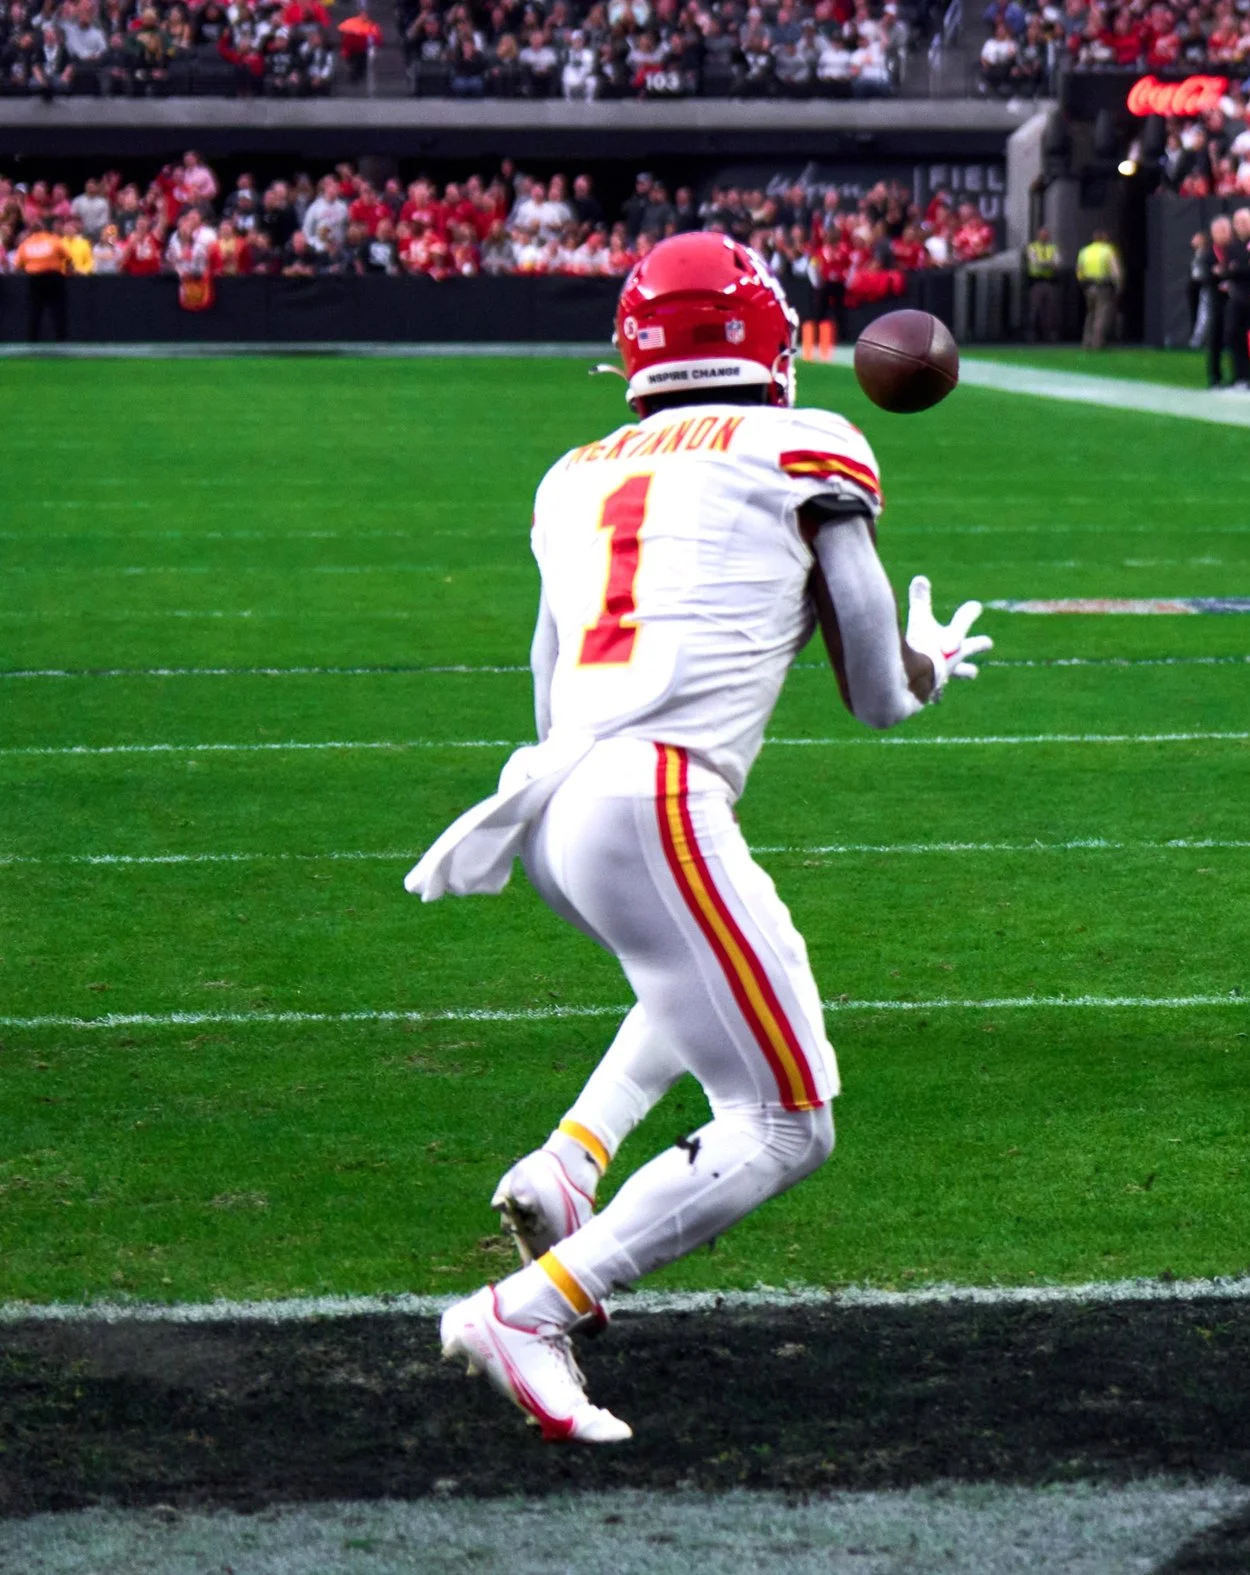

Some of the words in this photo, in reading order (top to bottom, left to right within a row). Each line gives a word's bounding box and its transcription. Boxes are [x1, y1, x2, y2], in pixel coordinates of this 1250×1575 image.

[929, 165, 1004, 192] FIEL
[691, 366, 740, 380] CHANGE
[576, 471, 655, 667] 1
